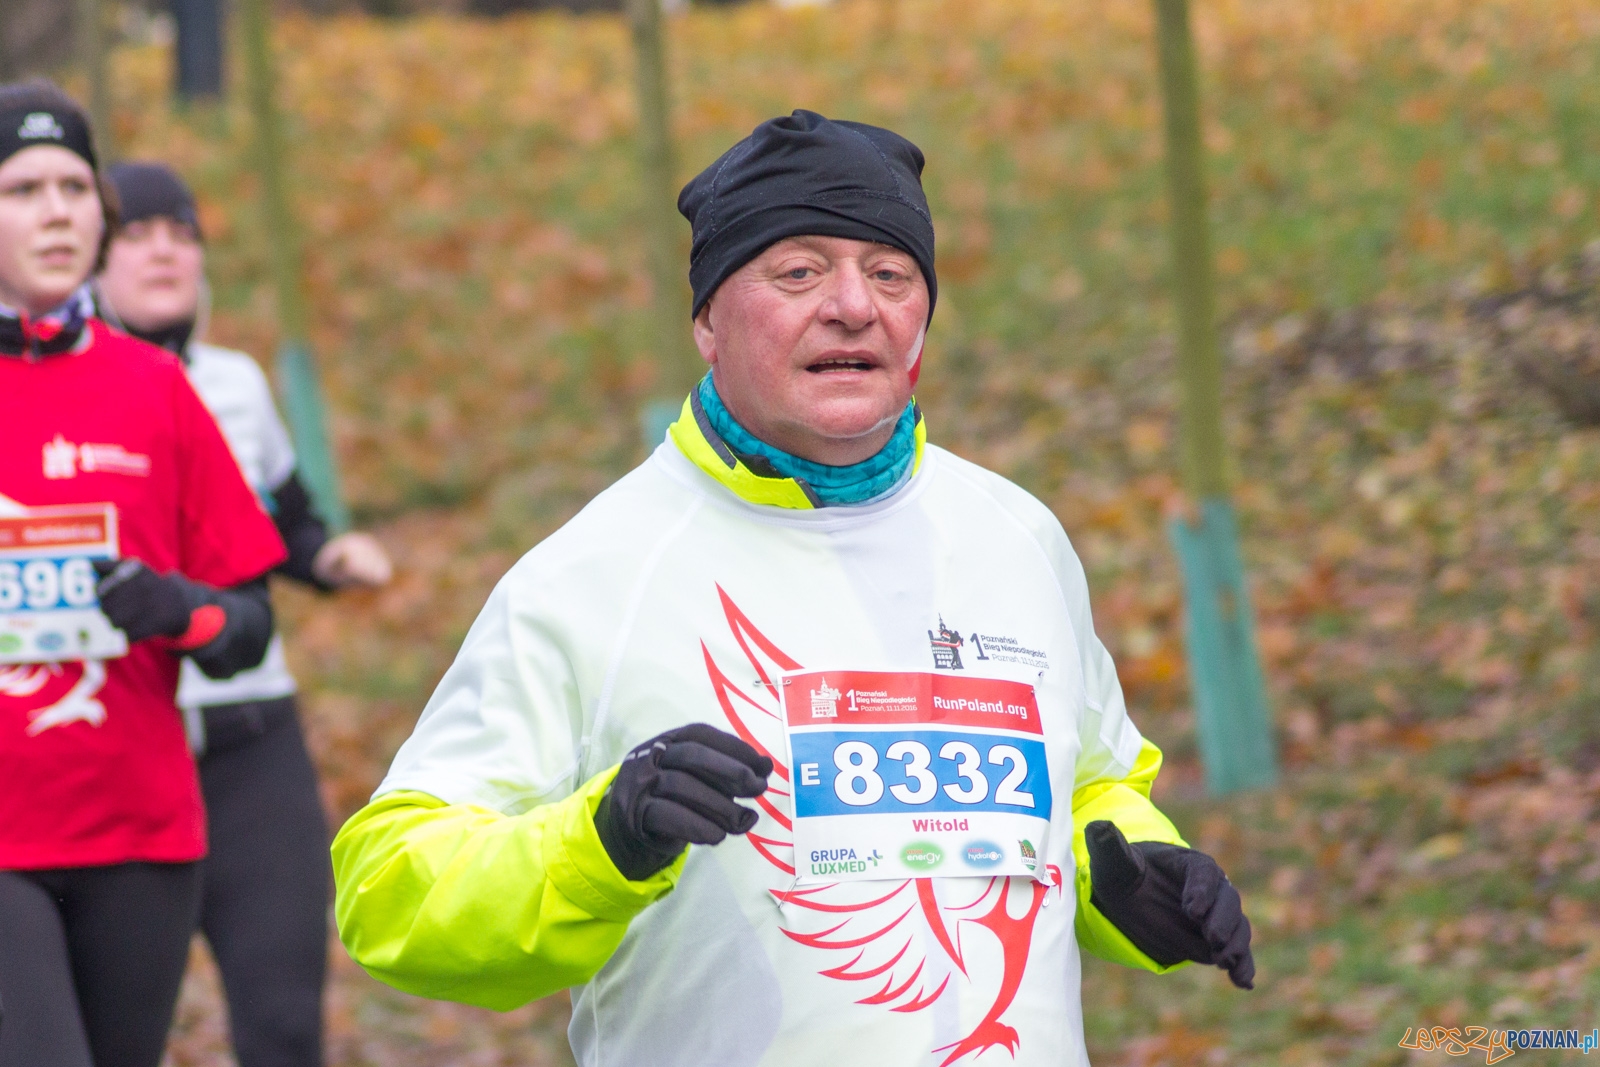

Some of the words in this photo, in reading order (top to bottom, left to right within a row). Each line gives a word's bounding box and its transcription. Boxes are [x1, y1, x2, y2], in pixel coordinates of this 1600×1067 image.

[970, 633, 989, 660] 1
[983, 643, 1001, 652] Bieg
[846, 689, 859, 711] 1
[933, 696, 1028, 719] RunPoland.org
[801, 763, 821, 787] E
[833, 740, 1036, 808] 8332
[912, 818, 969, 832] Witold
[810, 848, 857, 862] GRUPA
[906, 853, 941, 864] energy
[811, 861, 867, 875] LUXMED
